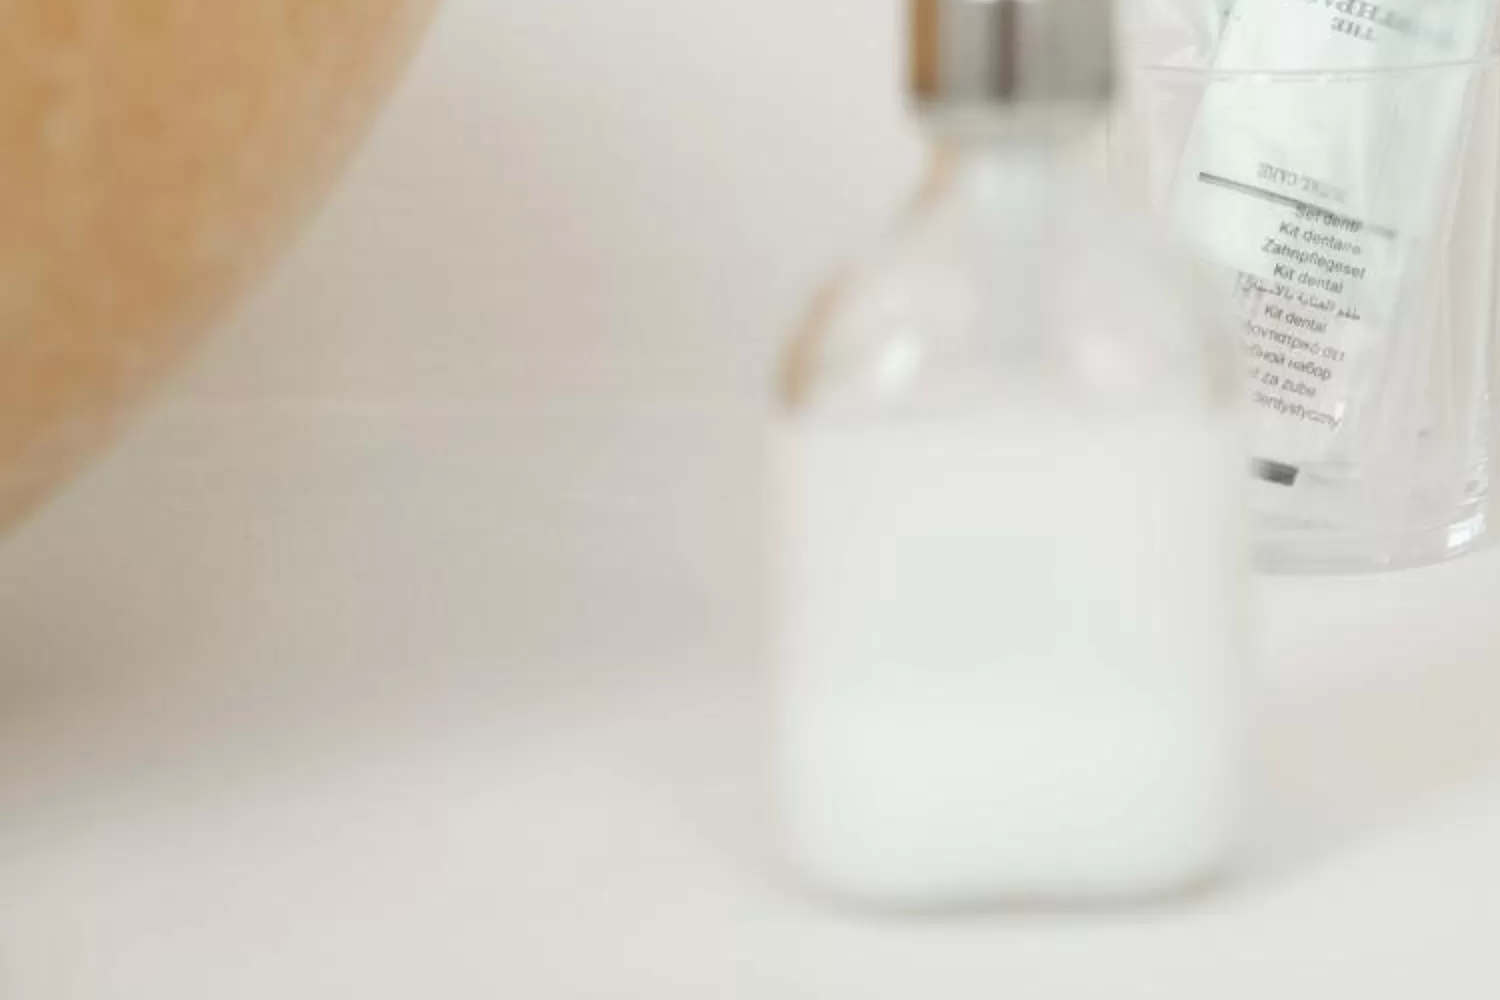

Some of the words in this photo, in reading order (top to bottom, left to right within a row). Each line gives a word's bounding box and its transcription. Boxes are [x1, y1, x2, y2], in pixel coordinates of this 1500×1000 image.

[1279, 221, 1300, 239] Kit
[1273, 263, 1294, 280] Kit
[1296, 271, 1344, 294] dental
[1263, 303, 1284, 320] Kit
